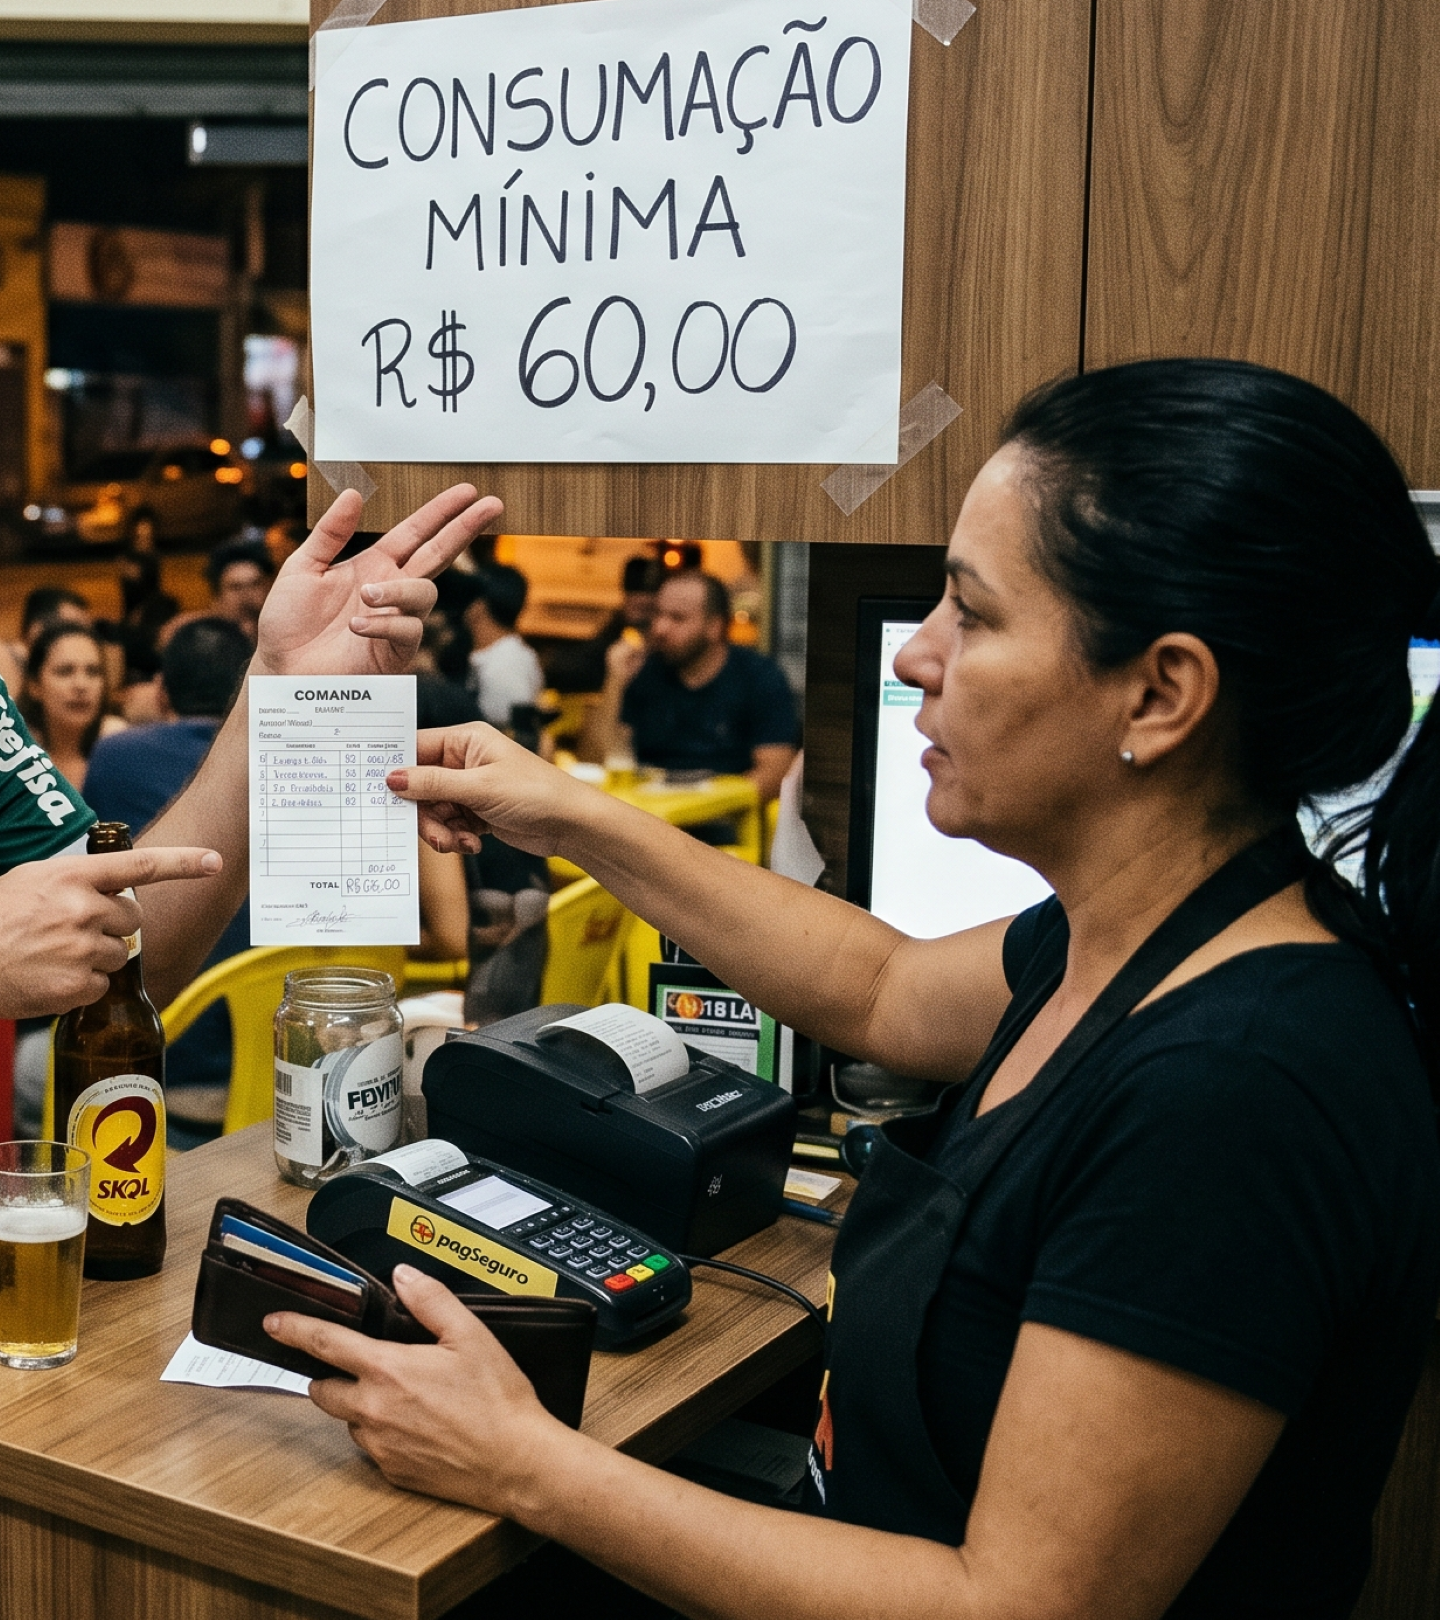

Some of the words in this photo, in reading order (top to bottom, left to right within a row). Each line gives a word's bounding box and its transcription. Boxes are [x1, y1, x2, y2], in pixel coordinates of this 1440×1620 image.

[343, 16, 882, 169] CONSUMAÇÃO
[361, 309, 475, 413] R$
[518, 295, 797, 412] 60,00
[294, 690, 372, 701] COMANDA
[97, 1177, 150, 1200] SKOL
[436, 1234, 529, 1285] pagSeguro
